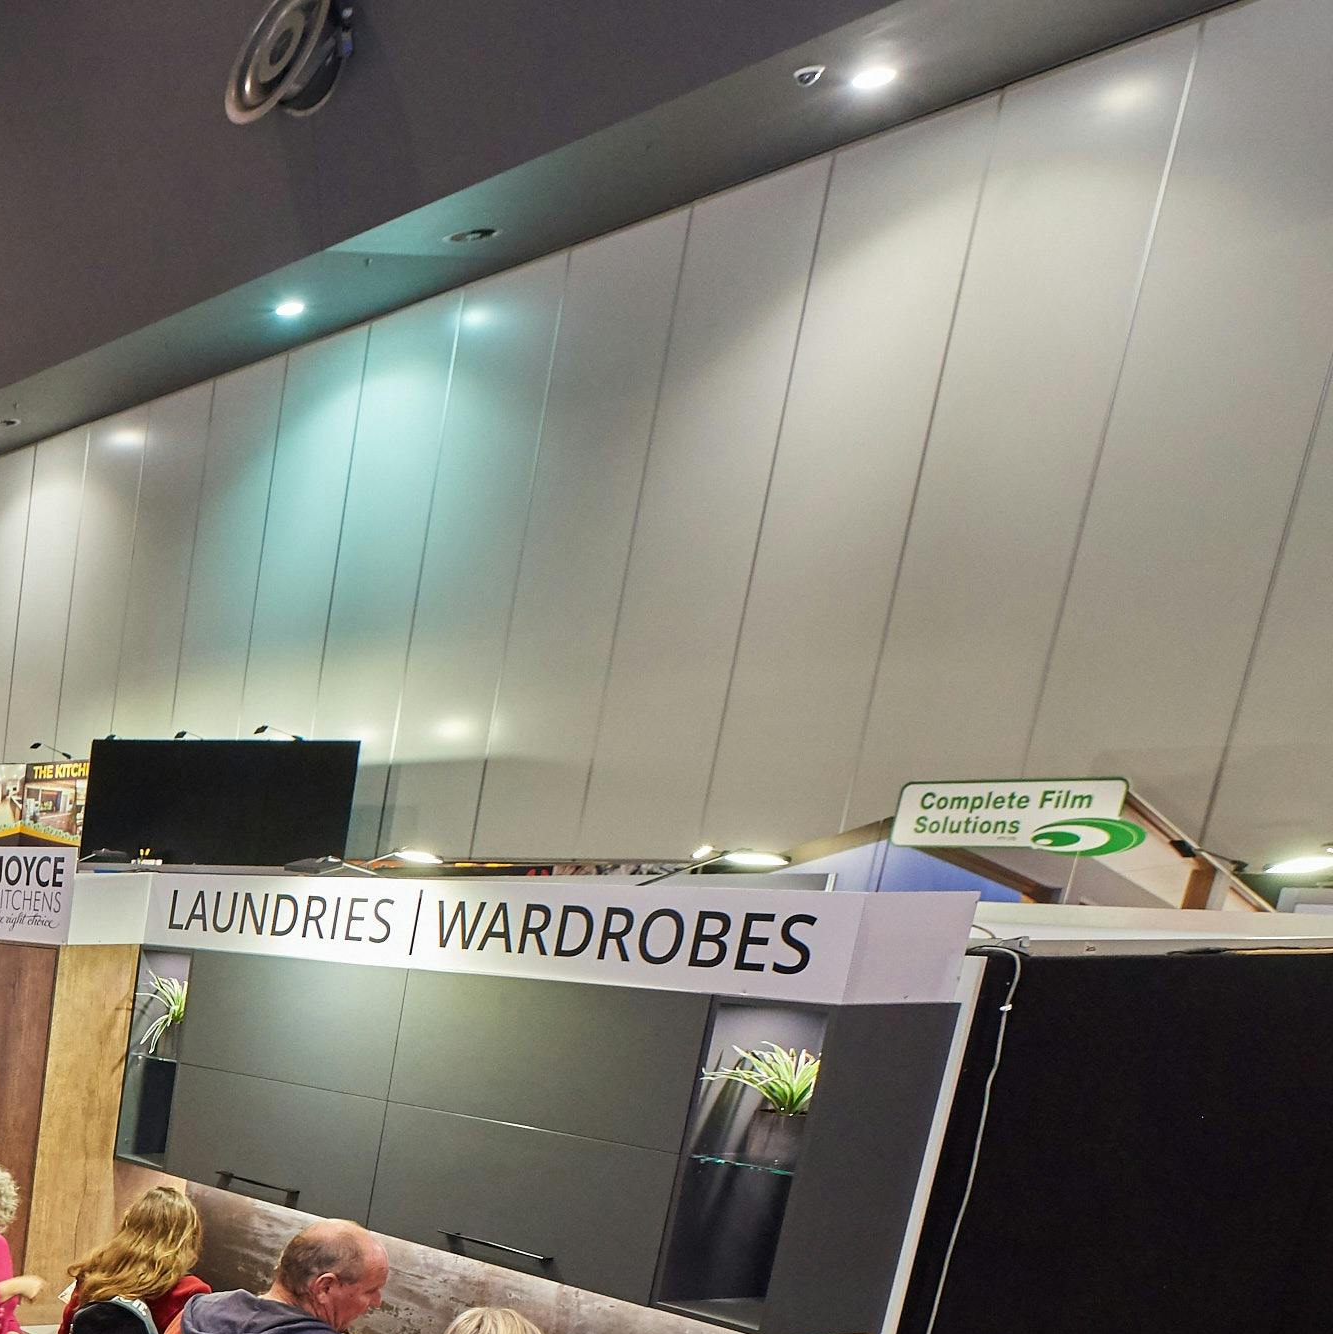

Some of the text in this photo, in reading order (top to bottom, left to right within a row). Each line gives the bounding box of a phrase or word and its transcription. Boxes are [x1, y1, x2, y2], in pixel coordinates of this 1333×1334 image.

[33, 764, 54, 779] THE
[920, 789, 1093, 813] Complete Film
[913, 815, 1021, 834] Solutions
[5, 913, 27, 932] right
[26, 914, 61, 929] choice
[168, 889, 818, 975] LAUNDRIES WARDROBES
